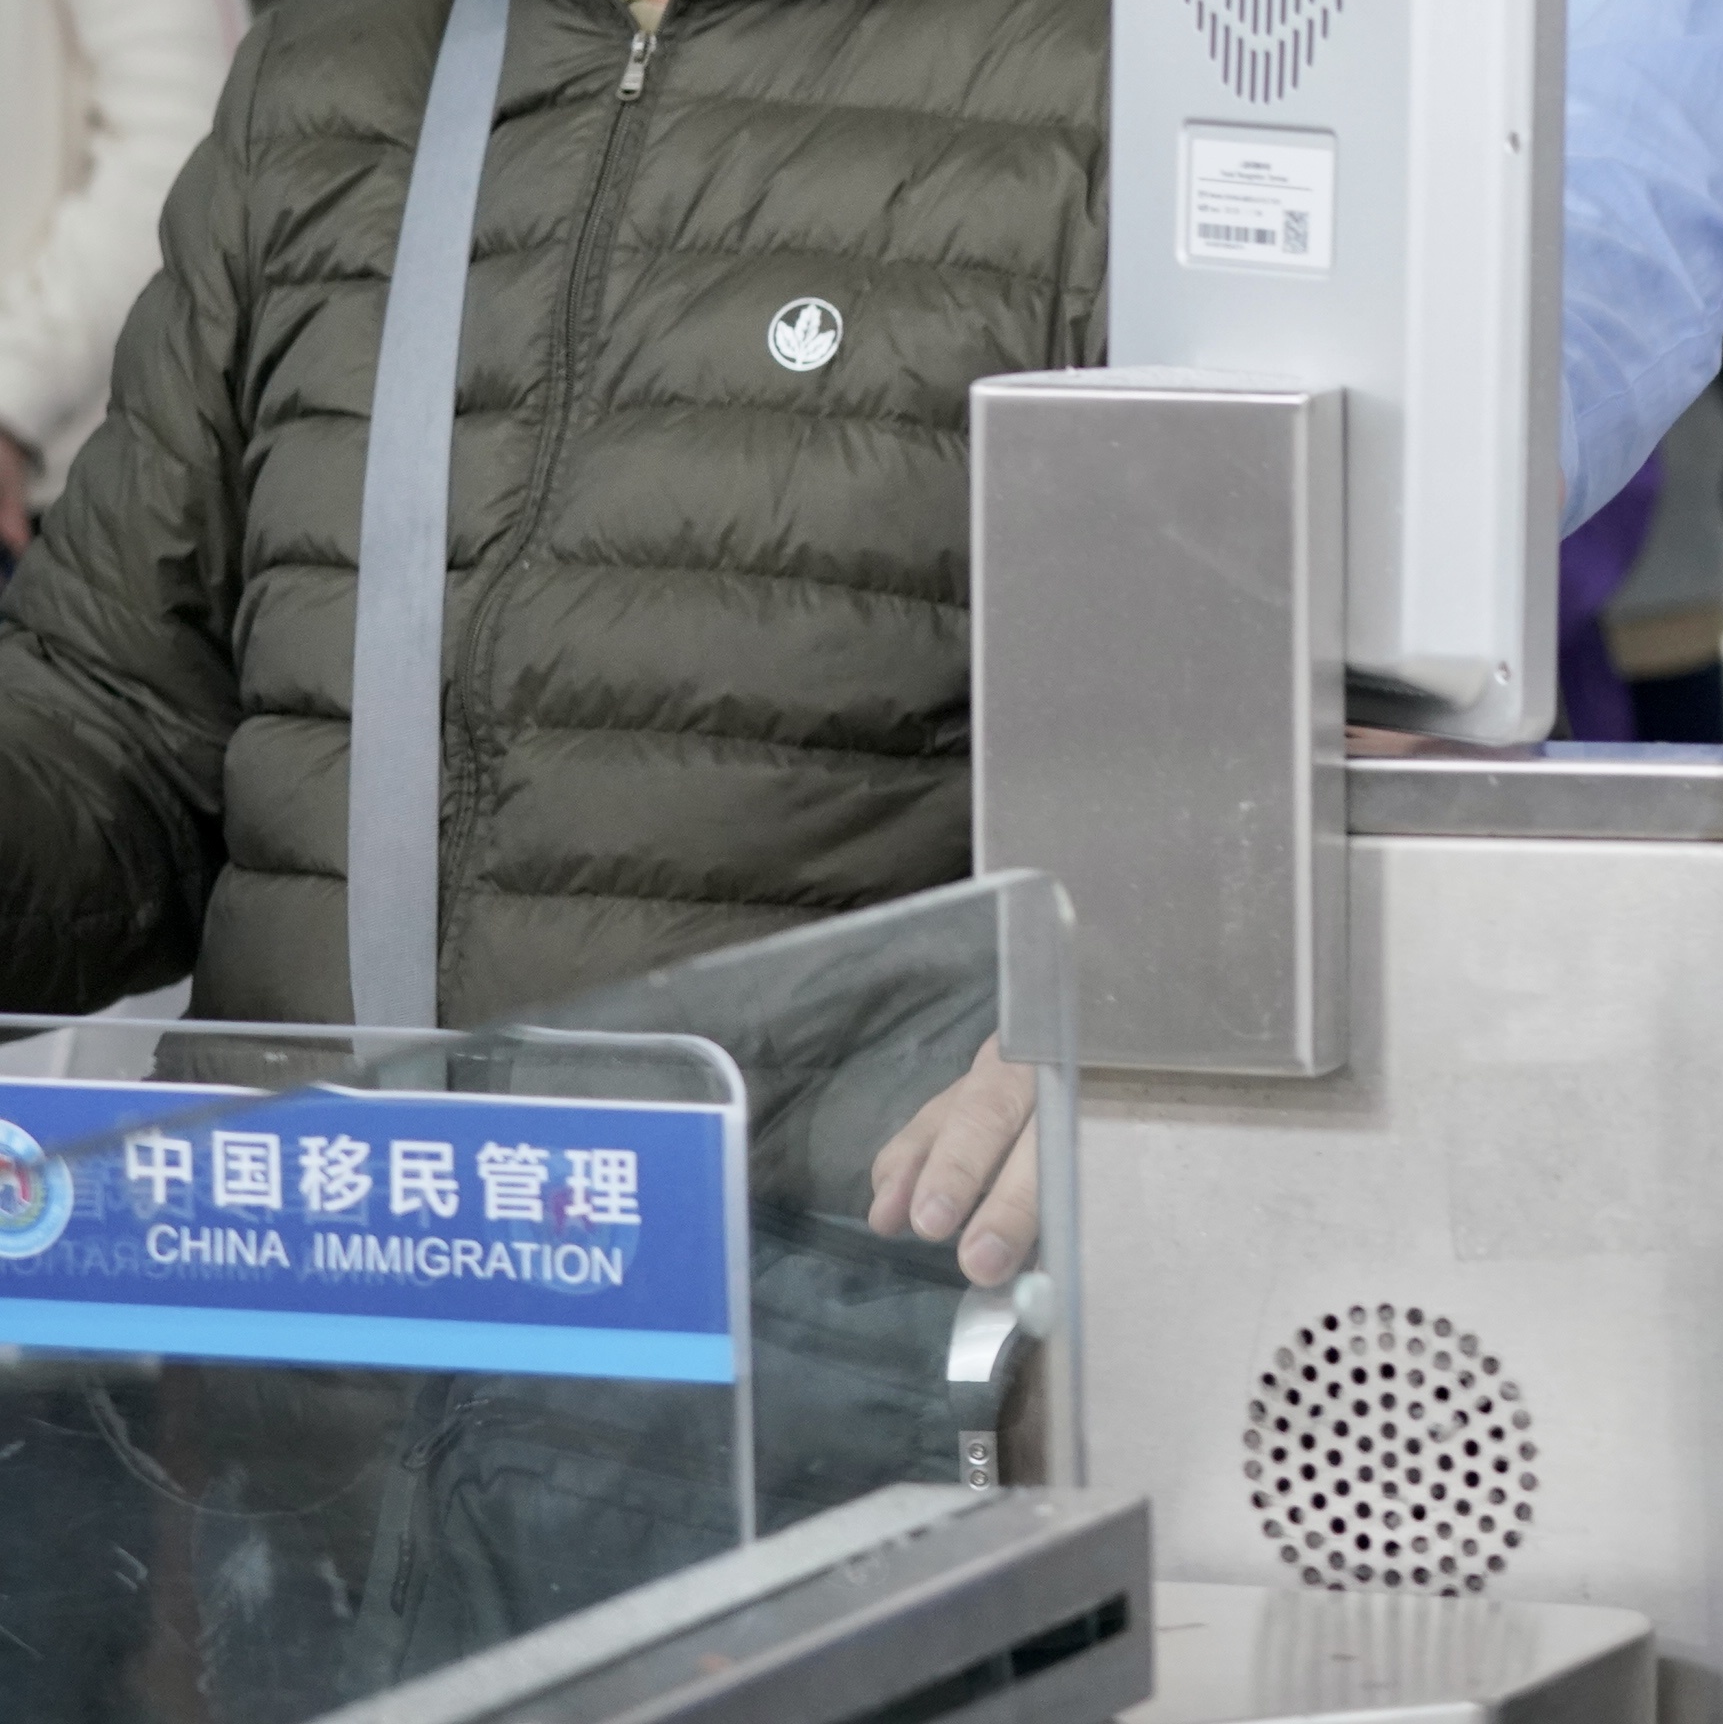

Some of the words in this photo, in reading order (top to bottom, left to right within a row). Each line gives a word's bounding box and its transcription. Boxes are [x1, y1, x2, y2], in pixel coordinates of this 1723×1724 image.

[124, 1128, 642, 1224] 中国移民管理
[147, 1224, 289, 1267] CHINA
[314, 1231, 624, 1285] IMMIGRATION
